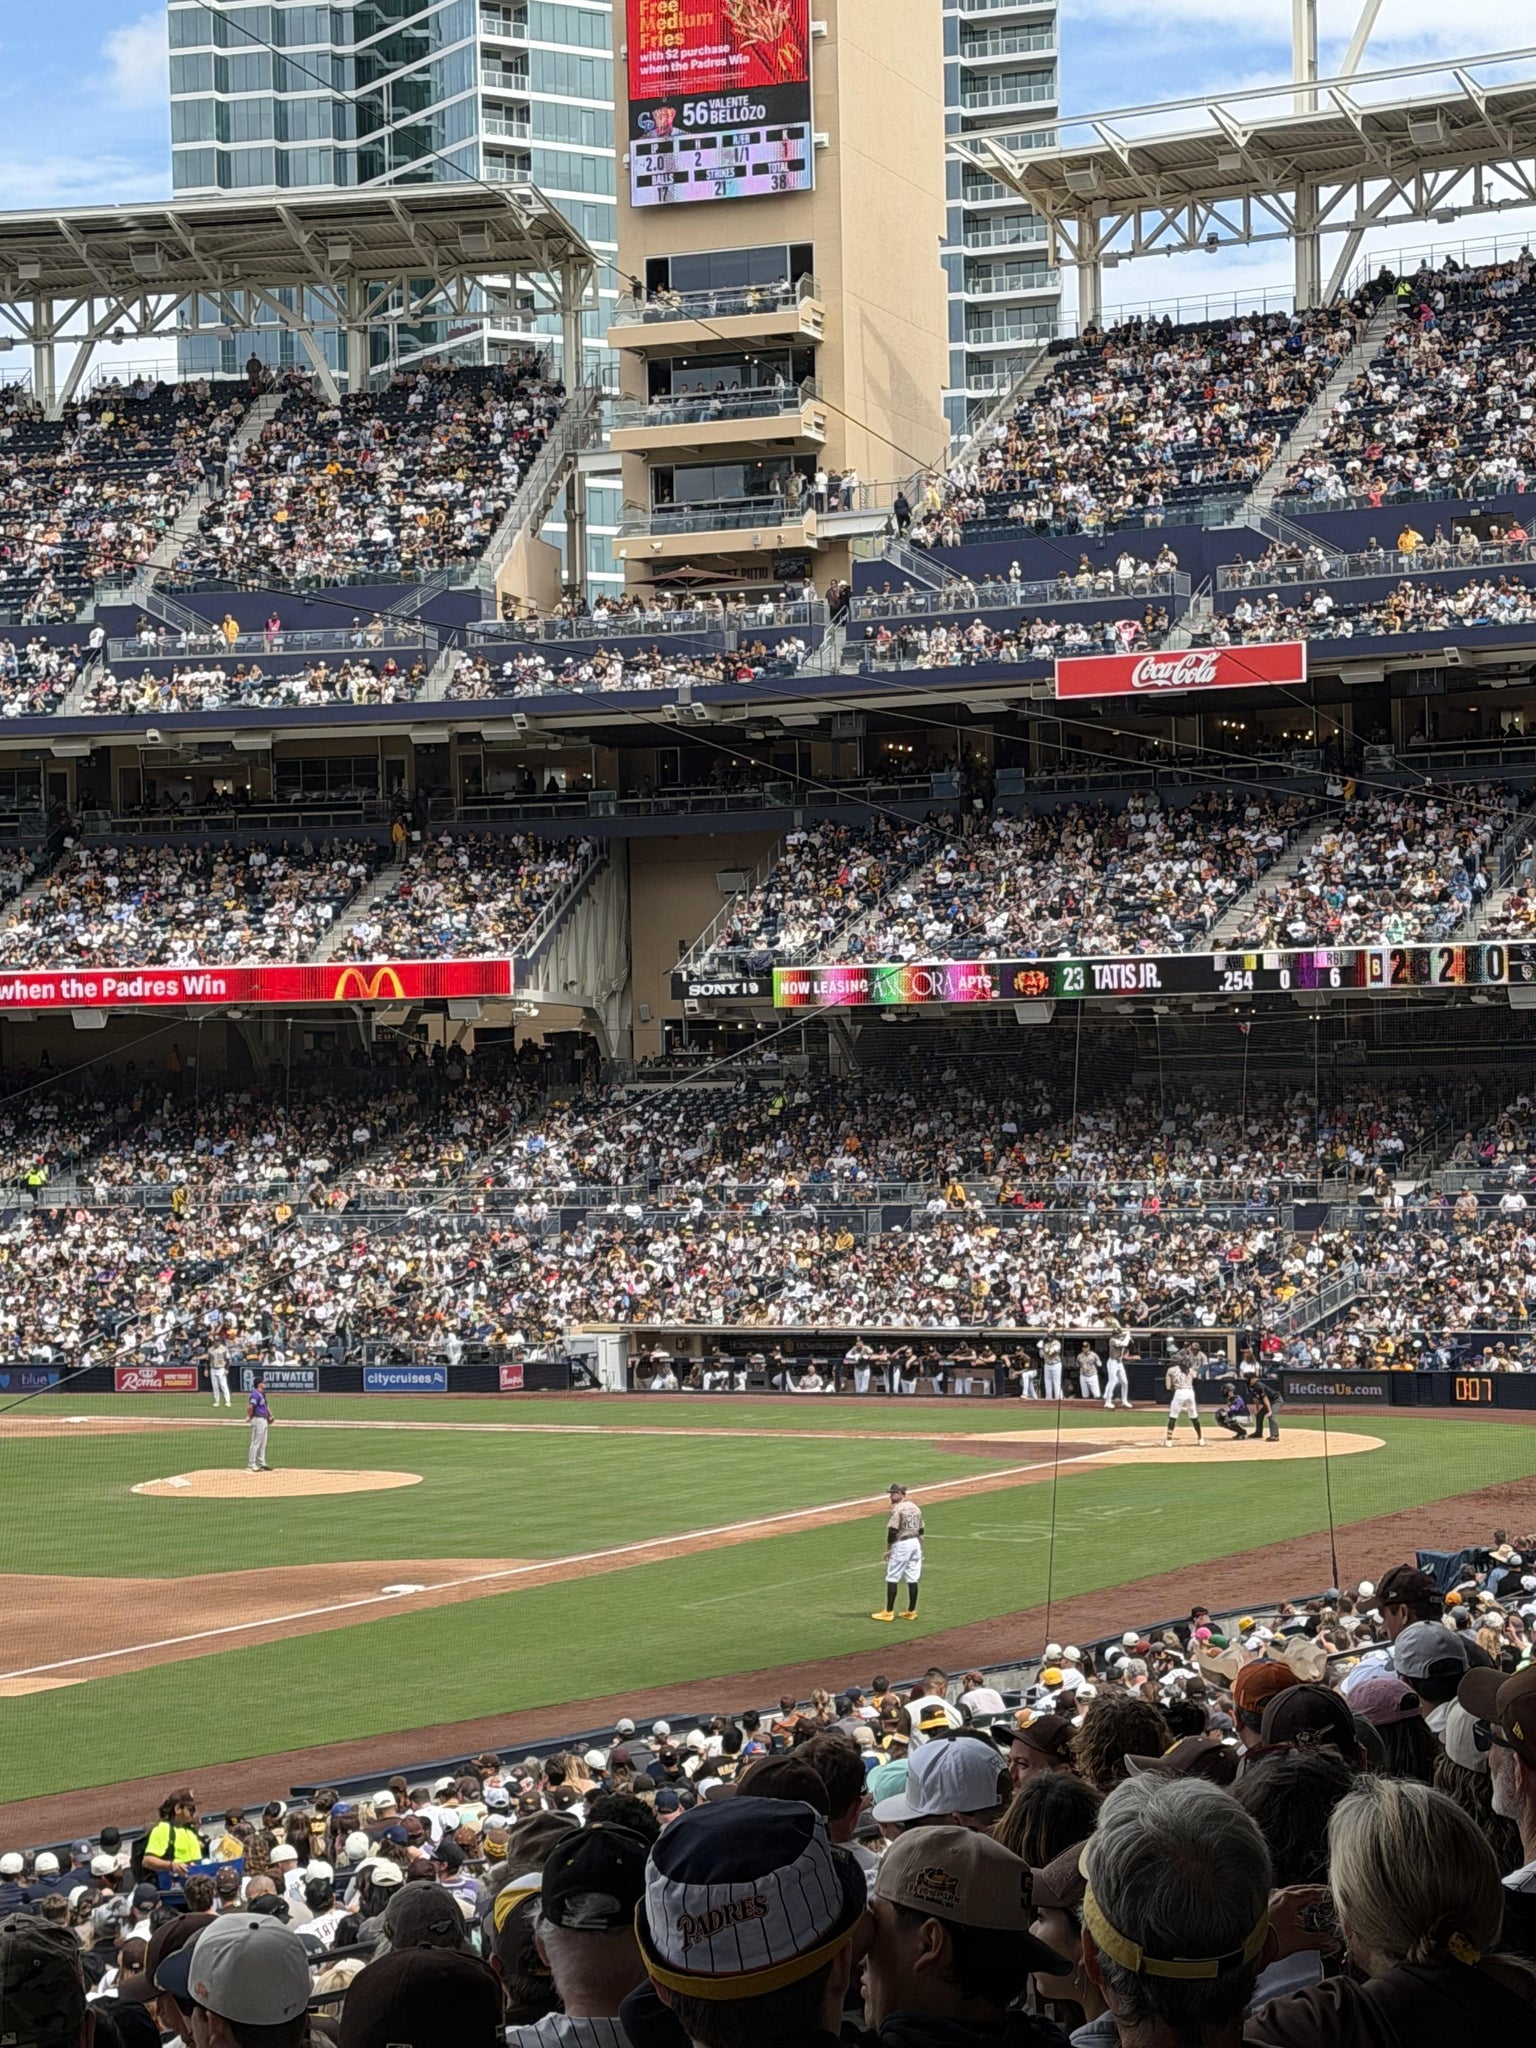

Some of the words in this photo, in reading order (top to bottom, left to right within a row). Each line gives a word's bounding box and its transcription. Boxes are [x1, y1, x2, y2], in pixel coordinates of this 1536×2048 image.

[640, 0, 679, 15] Free
[640, 11, 714, 33] Medium
[640, 31, 685, 49] Fries
[640, 49, 665, 62] with
[665, 48, 680, 60] $2
[680, 44, 730, 59] purchase
[640, 63, 670, 75] when
[671, 60, 690, 72] the
[690, 57, 727, 70] Padres
[728, 53, 751, 66] Win
[709, 95, 750, 110] VALENTE
[682, 101, 709, 127] 56
[710, 104, 766, 125] BELLOZO
[651, 143, 659, 154] IP
[782, 129, 789, 140] K
[646, 155, 664, 172] 2.0
[694, 151, 702, 167] 2
[734, 146, 749, 163] 1/1
[782, 142, 788, 158] 1
[651, 173, 674, 186] BALLS
[705, 166, 736, 180] STRIKES
[768, 161, 789, 174] TOTAL
[657, 186, 669, 202] 17
[715, 180, 727, 196] 21
[771, 174, 787, 191] 38
[1131, 651, 1221, 688] Coca-Cola
[1390, 948, 1407, 985] 2
[1438, 946, 1455, 984] 2
[0, 979, 55, 1000] when
[60, 978, 98, 998] the
[102, 976, 178, 998] Padres
[182, 973, 226, 996] Win
[780, 981, 810, 995] NOW
[813, 979, 869, 994] LEASING
[958, 975, 993, 990] APTS
[1062, 966, 1085, 992] 23
[1091, 964, 1138, 990] TATIS
[1138, 964, 1162, 989] JR.
[1218, 970, 1255, 992] .254
[1279, 969, 1291, 990] 0
[1329, 967, 1341, 988] 6
[688, 983, 741, 997] SONY
[21, 1373, 48, 1385] blue
[121, 1372, 162, 1390] Roma
[263, 1371, 314, 1382] CUTWATER
[367, 1372, 431, 1386] citycruises
[1289, 1383, 1383, 1396] HeGetsUs.com
[677, 1895, 769, 1952] PADRES
